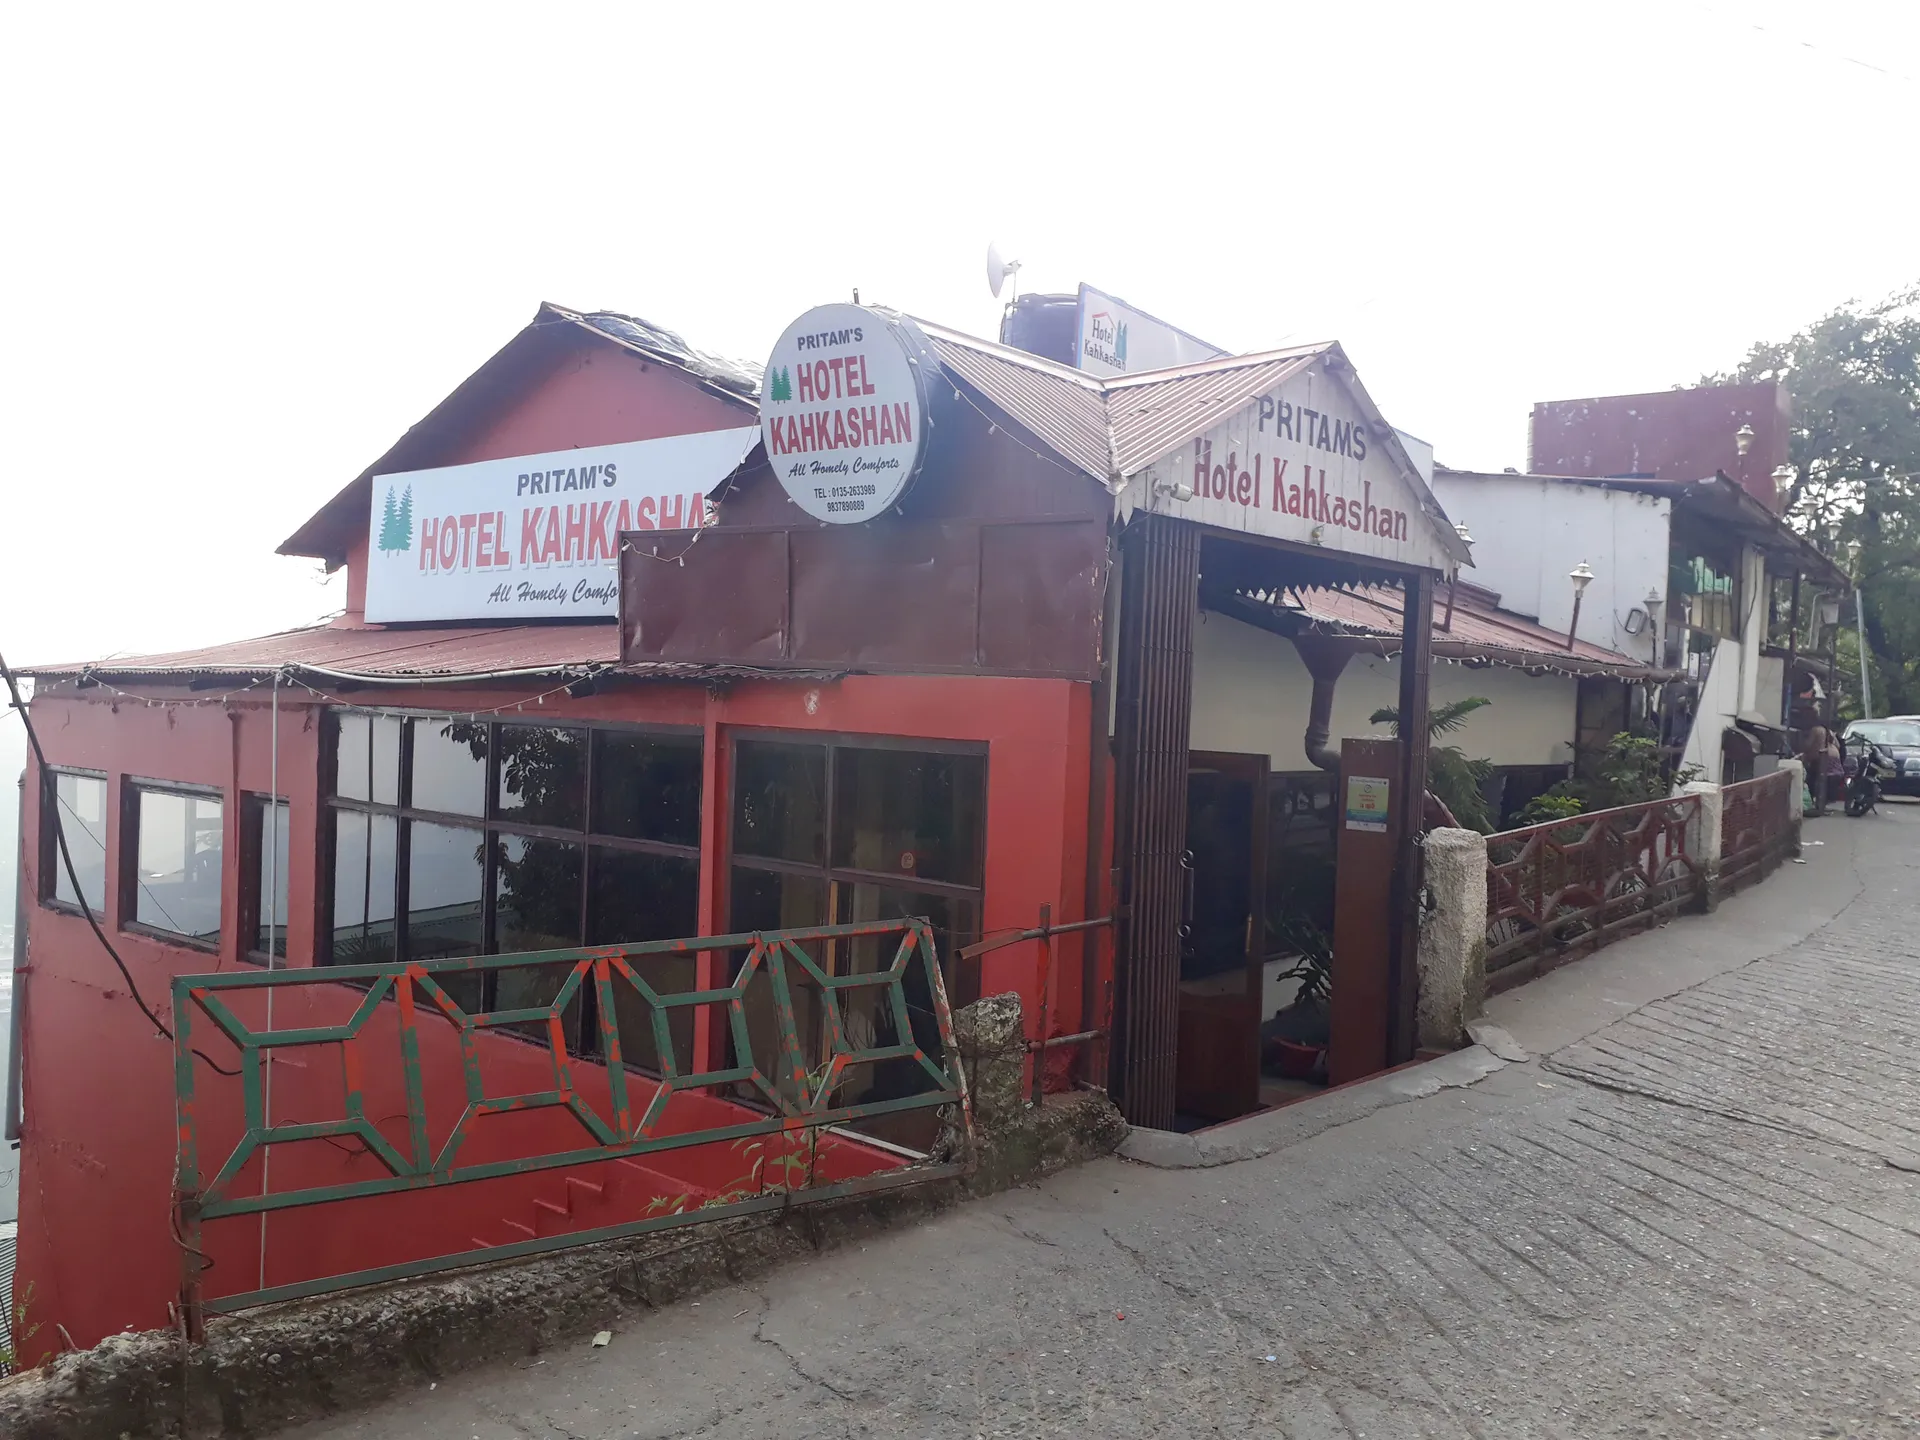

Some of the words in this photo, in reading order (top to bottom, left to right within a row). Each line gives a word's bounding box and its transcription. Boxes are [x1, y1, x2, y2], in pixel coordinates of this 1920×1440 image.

[797, 328, 863, 351] PRITAM'S
[1092, 318, 1114, 345] Hotel
[1084, 338, 1126, 372] Kahkashan
[797, 354, 875, 403] HOTEL
[770, 401, 912, 455] KAHKASHAN
[1259, 395, 1367, 461] PRITAM'S
[517, 463, 617, 496] PRITAM'S
[788, 462, 806, 478] All
[809, 460, 849, 476] Homely
[852, 456, 900, 474] Comforts
[814, 488, 827, 499] TEL
[832, 484, 875, 498] 0135-2633989
[1193, 437, 1261, 508] Hotel
[1272, 457, 1408, 542] Kahkashan
[419, 510, 509, 571] HOTEL
[519, 492, 721, 564] KAHKASHA
[487, 582, 512, 604] All
[516, 581, 567, 605] Homely
